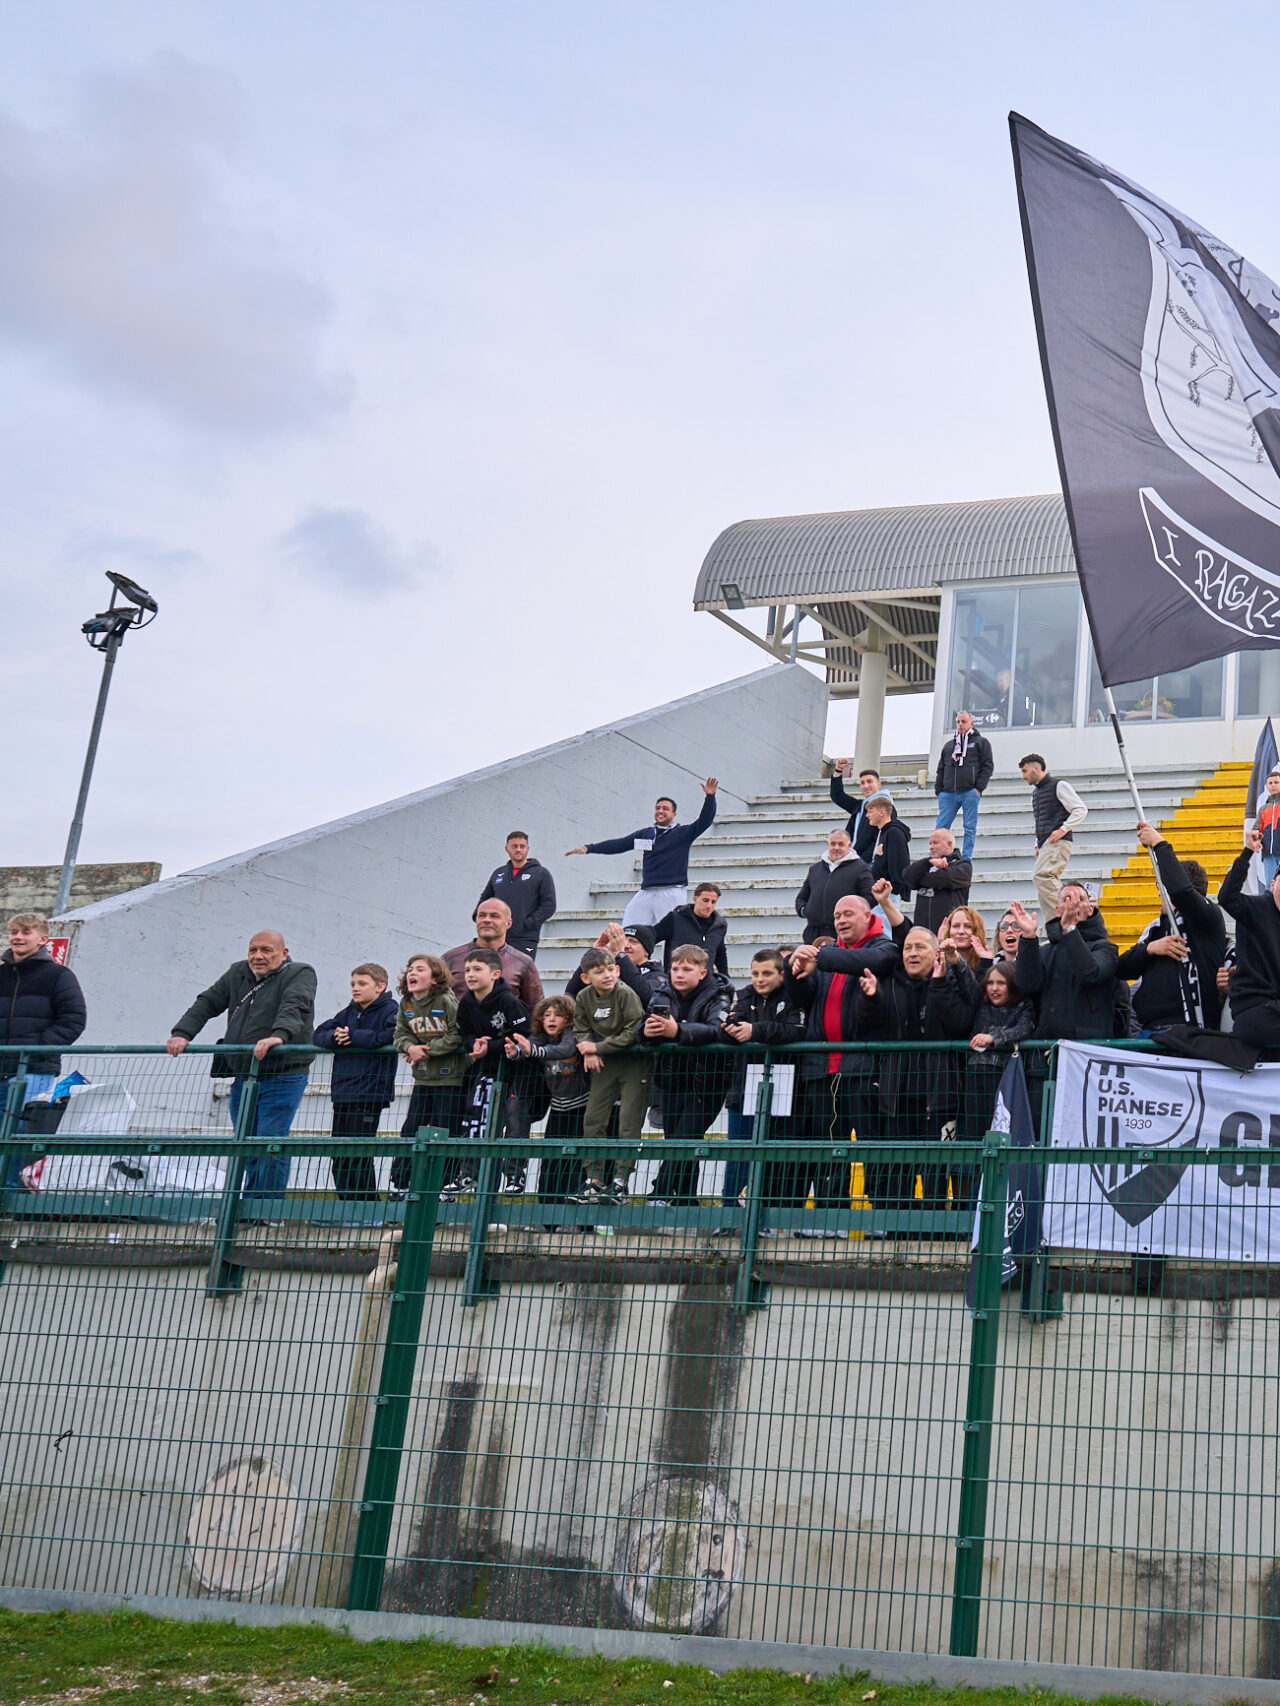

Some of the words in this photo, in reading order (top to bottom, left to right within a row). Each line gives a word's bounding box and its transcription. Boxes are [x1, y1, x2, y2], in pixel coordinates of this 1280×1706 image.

[1161, 525, 1182, 567] I
[408, 1016, 449, 1035] TEAM
[1098, 1079, 1135, 1096] U.S.
[1098, 1096, 1184, 1117] PIANESE
[1125, 1118, 1153, 1130] 1930
